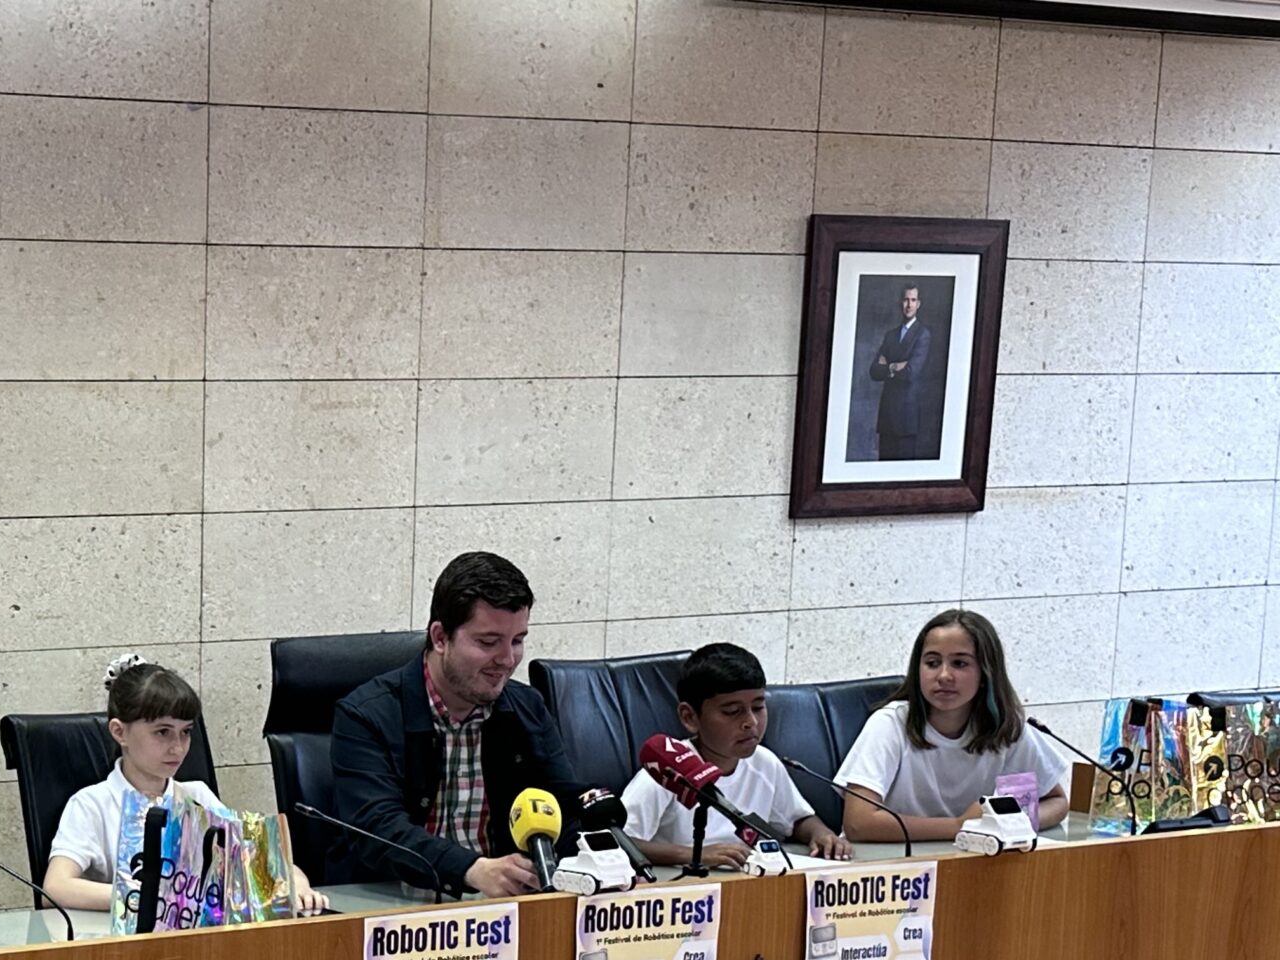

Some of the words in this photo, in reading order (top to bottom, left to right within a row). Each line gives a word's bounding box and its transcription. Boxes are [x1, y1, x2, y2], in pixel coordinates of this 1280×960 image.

[814, 875, 886, 908] RoboTIC
[891, 873, 930, 902] Fest
[584, 899, 664, 933] RoboTIC
[671, 895, 714, 926] Fest
[372, 920, 458, 956] RoboTIC
[465, 915, 511, 948] Fest
[604, 935, 631, 945] Festival
[633, 934, 642, 942] de
[903, 927, 923, 940] Crea
[841, 942, 887, 960] Interactúa
